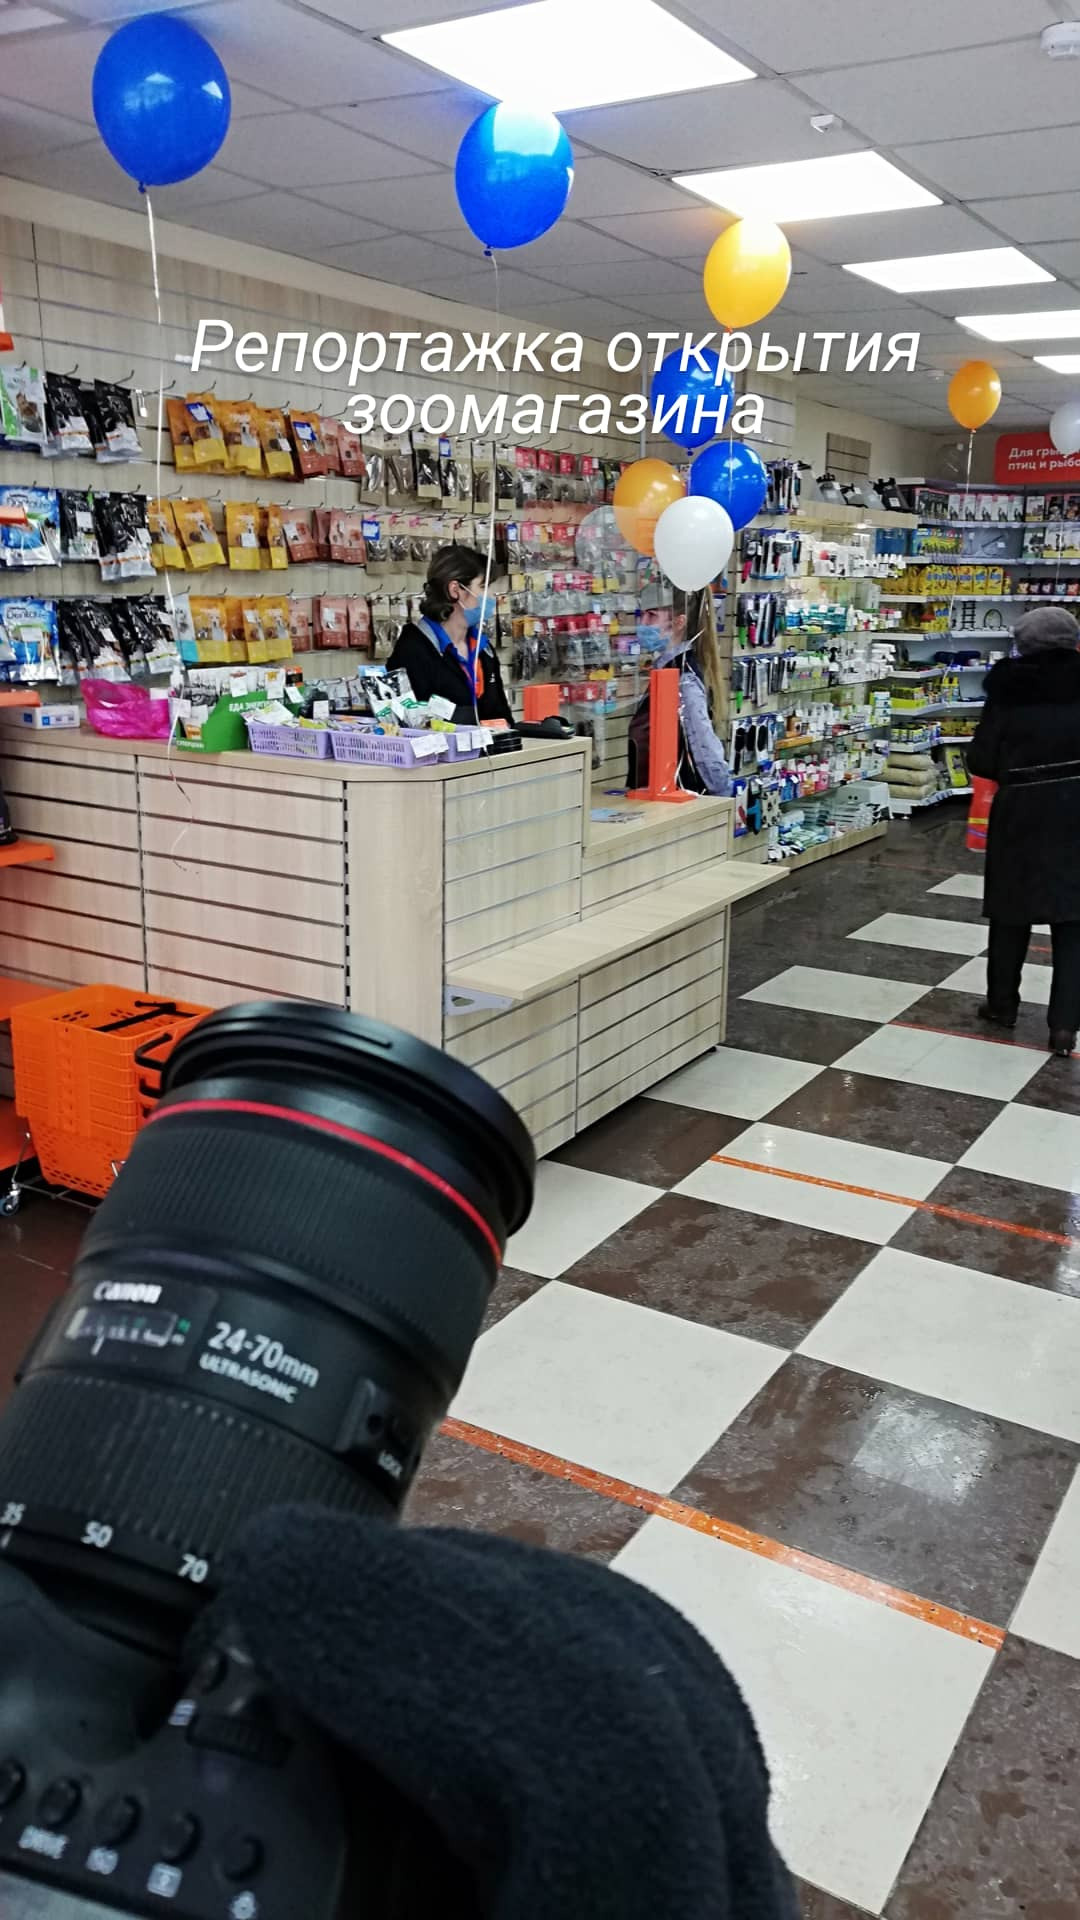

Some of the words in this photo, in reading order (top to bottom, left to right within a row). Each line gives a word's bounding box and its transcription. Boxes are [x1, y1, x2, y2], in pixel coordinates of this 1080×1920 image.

[1008, 448, 1033, 459] Для
[1008, 462, 1037, 472] птиц
[1039, 461, 1047, 469] и
[93, 1281, 162, 1304] Canon
[208, 1321, 319, 1388] 24-70mm
[199, 1352, 299, 1404] ULTRASONIC
[80, 1521, 113, 1548] 50
[178, 1553, 209, 1583] 70
